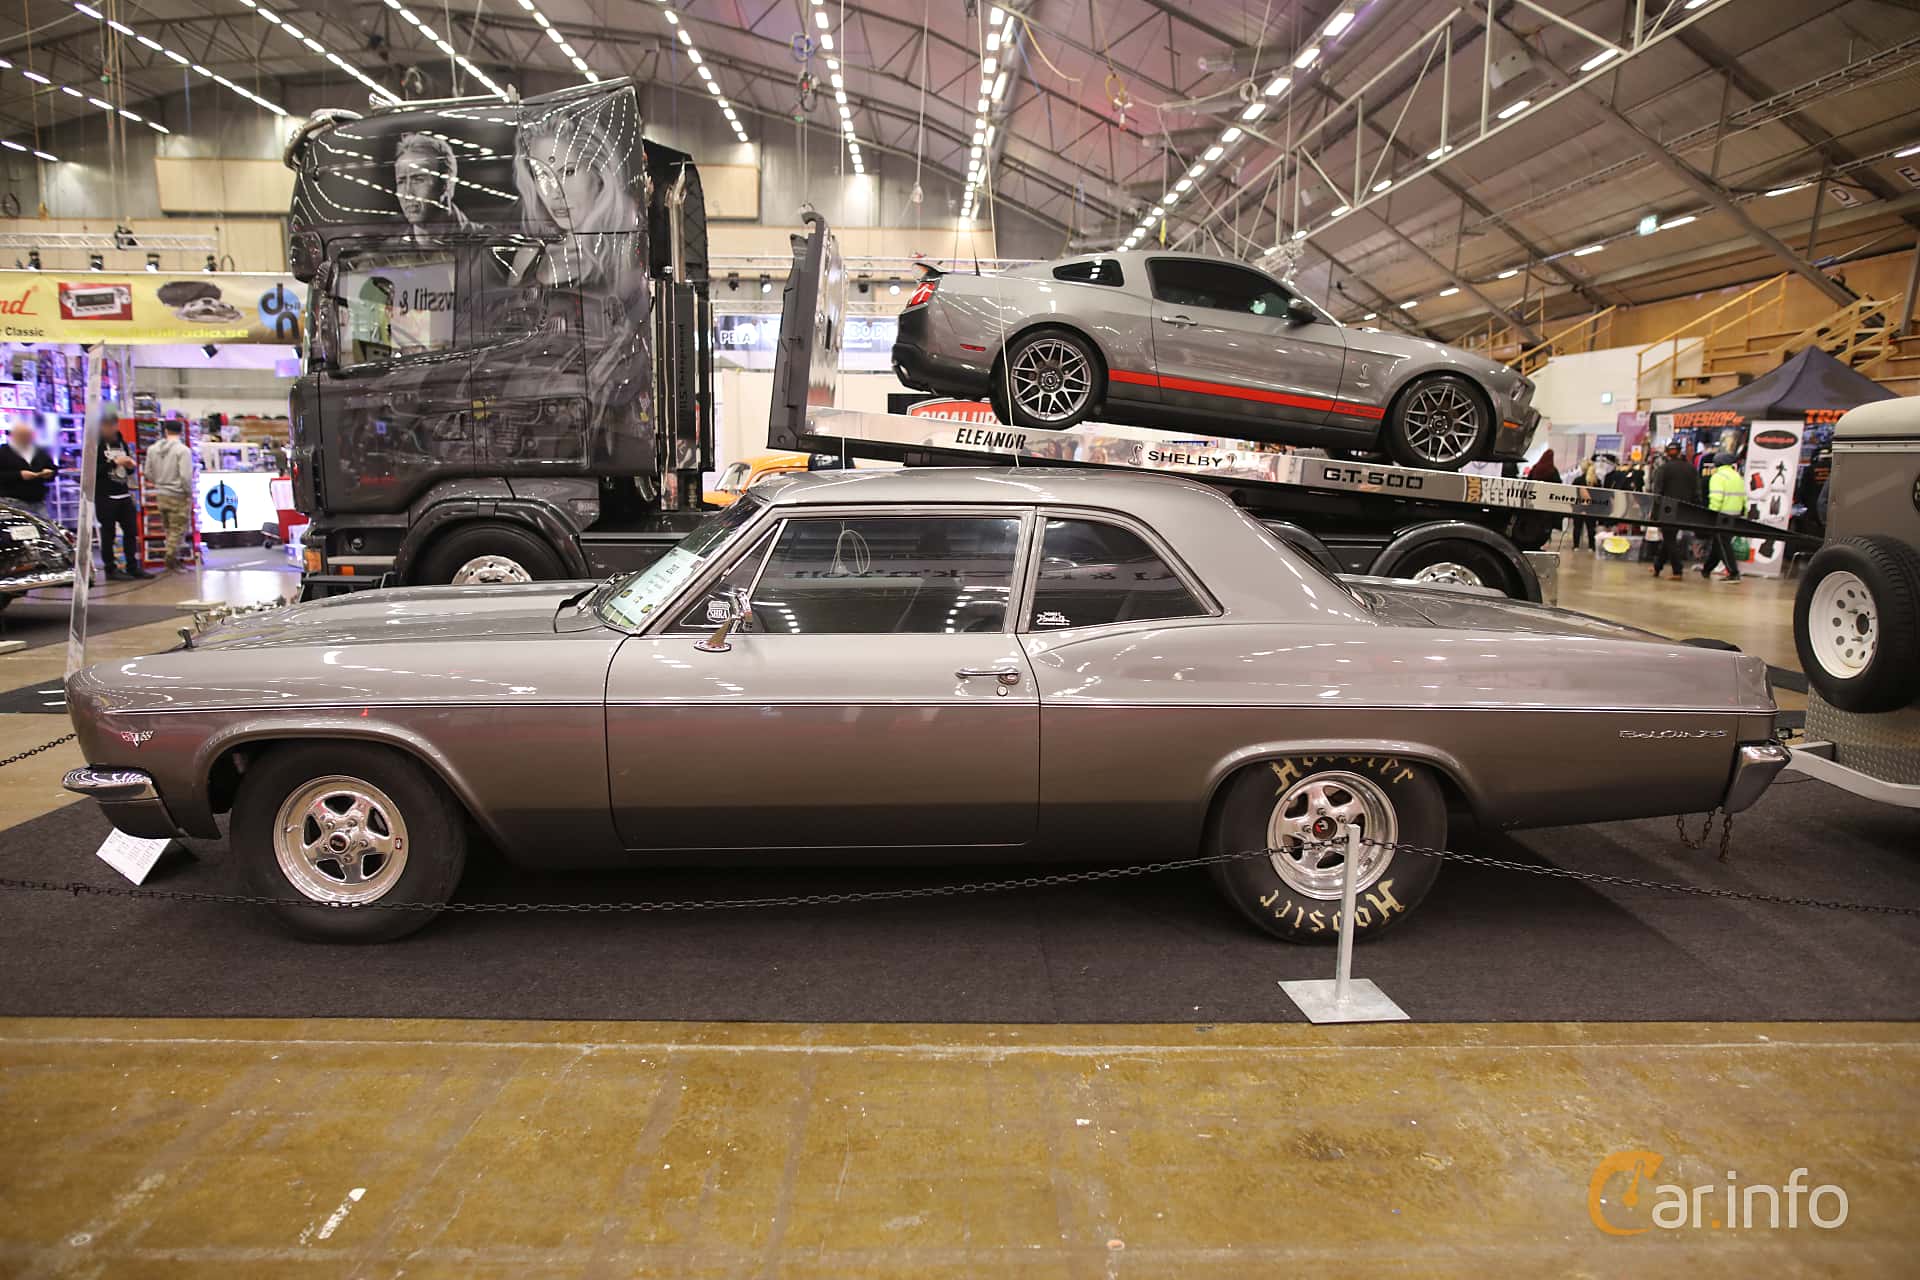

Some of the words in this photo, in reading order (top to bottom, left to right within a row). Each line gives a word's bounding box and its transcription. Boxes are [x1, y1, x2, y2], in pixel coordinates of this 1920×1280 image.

[5, 326, 45, 337] Classic
[955, 428, 1027, 449] ELEANOR
[1148, 450, 1223, 468] SHELBY
